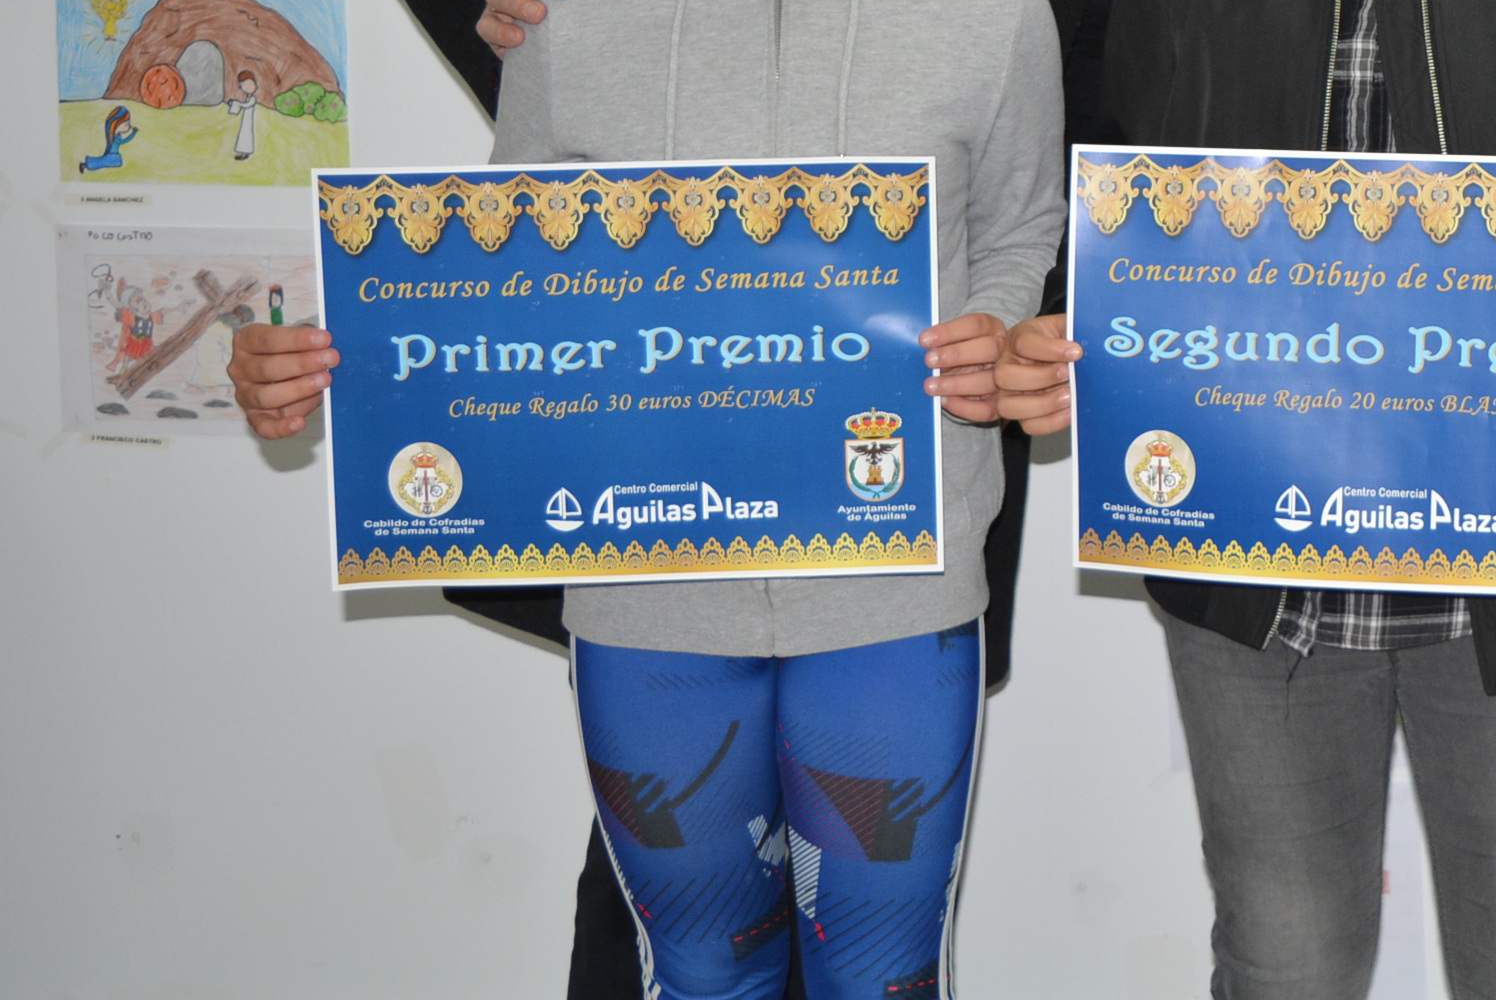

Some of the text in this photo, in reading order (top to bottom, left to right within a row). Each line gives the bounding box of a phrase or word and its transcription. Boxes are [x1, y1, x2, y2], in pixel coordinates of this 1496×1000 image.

[358, 265, 899, 302] Concurso de Dibujo de Semana Santa
[1108, 257, 1237, 283] Concurso
[1247, 259, 1279, 285] de
[1289, 261, 1387, 296] Dibujo
[1396, 263, 1428, 289] de
[390, 325, 870, 381] Primer Premio
[1104, 316, 1385, 370] Segundo
[449, 385, 816, 421] Cheque Regalo 30 euros DÉCIMAS
[1194, 385, 1267, 412] Cheque
[1274, 388, 1344, 414] Regalo
[1350, 391, 1376, 410] 20
[1381, 395, 1435, 412] euros
[613, 481, 698, 495] Centro Comercial
[1343, 485, 1428, 499] Centro Comercial
[592, 481, 779, 530] Aguilas Plaza
[837, 503, 917, 514] Ayuntamiento
[847, 513, 862, 521] de
[1102, 502, 1143, 515] Cabildo
[1145, 507, 1159, 515] de
[1320, 486, 1425, 534] Aguilas
[363, 519, 409, 528] Cabildo
[411, 518, 426, 527] de
[374, 526, 476, 536] de Semana Santa
[1112, 511, 1205, 528] de Semana Santa
